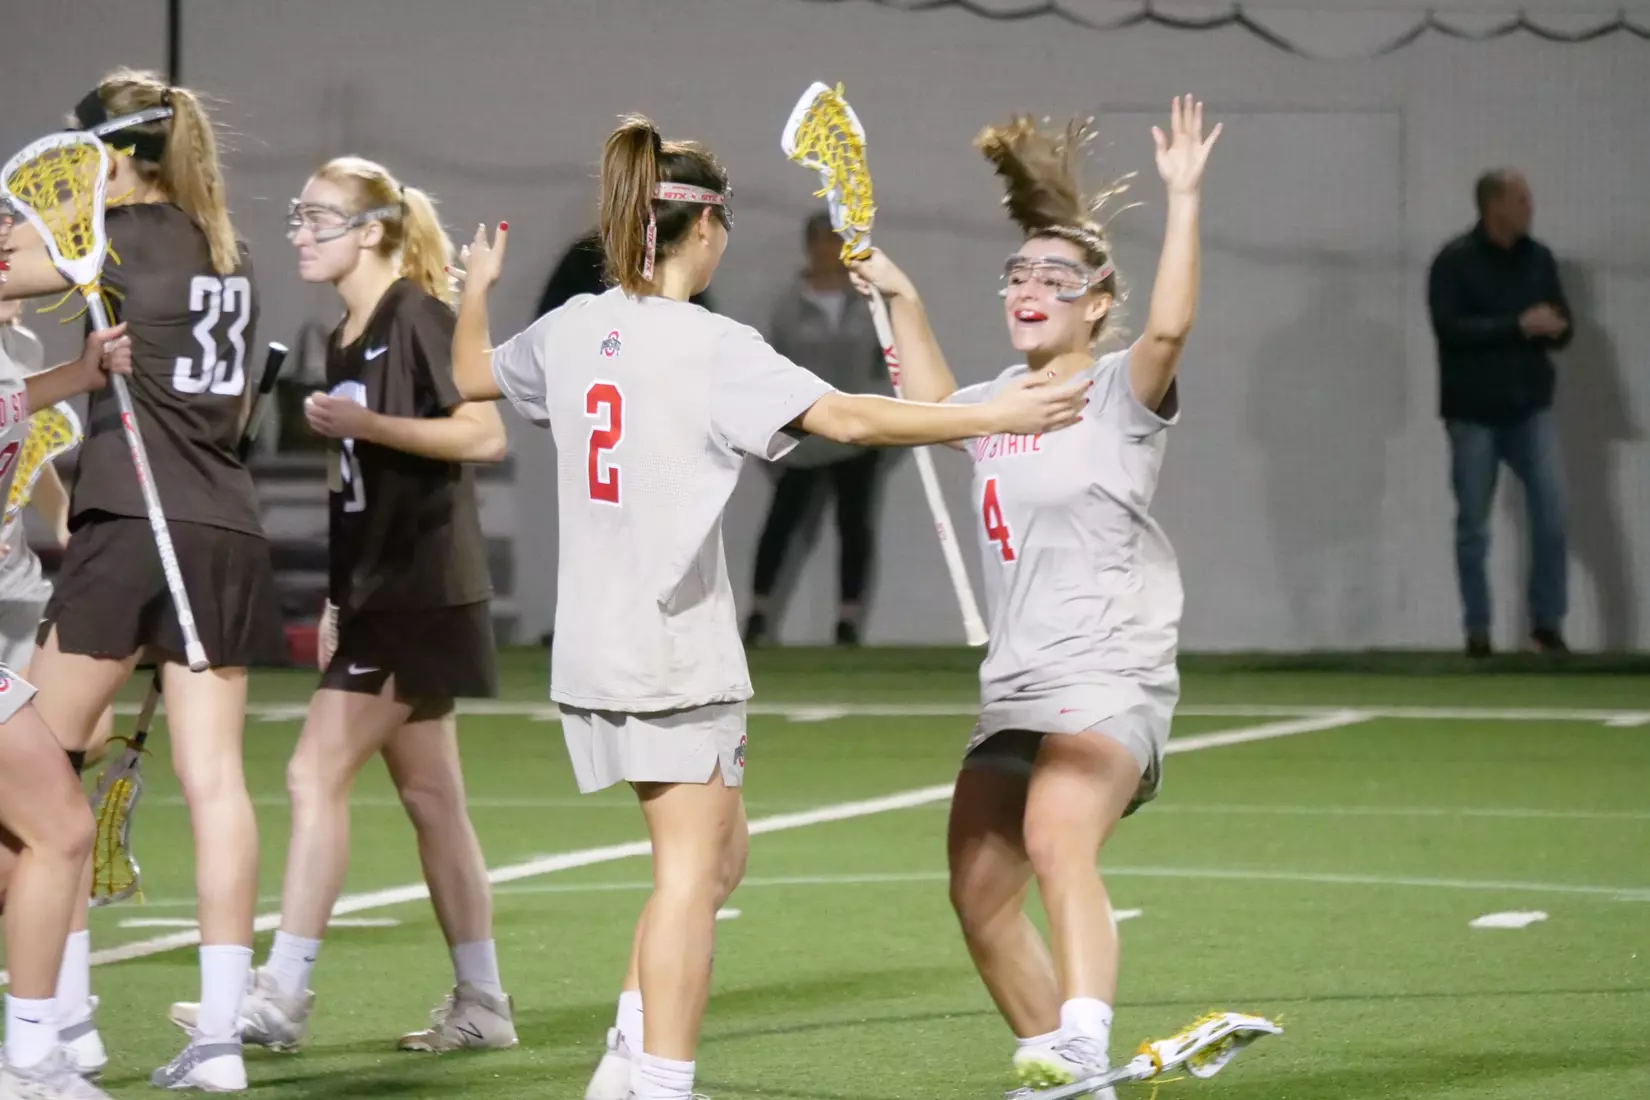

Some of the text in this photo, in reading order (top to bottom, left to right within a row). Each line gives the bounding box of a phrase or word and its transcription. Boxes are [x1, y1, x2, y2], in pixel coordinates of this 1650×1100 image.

[173, 276, 250, 396] 33
[585, 381, 624, 505] 2
[982, 478, 1016, 562] 4
